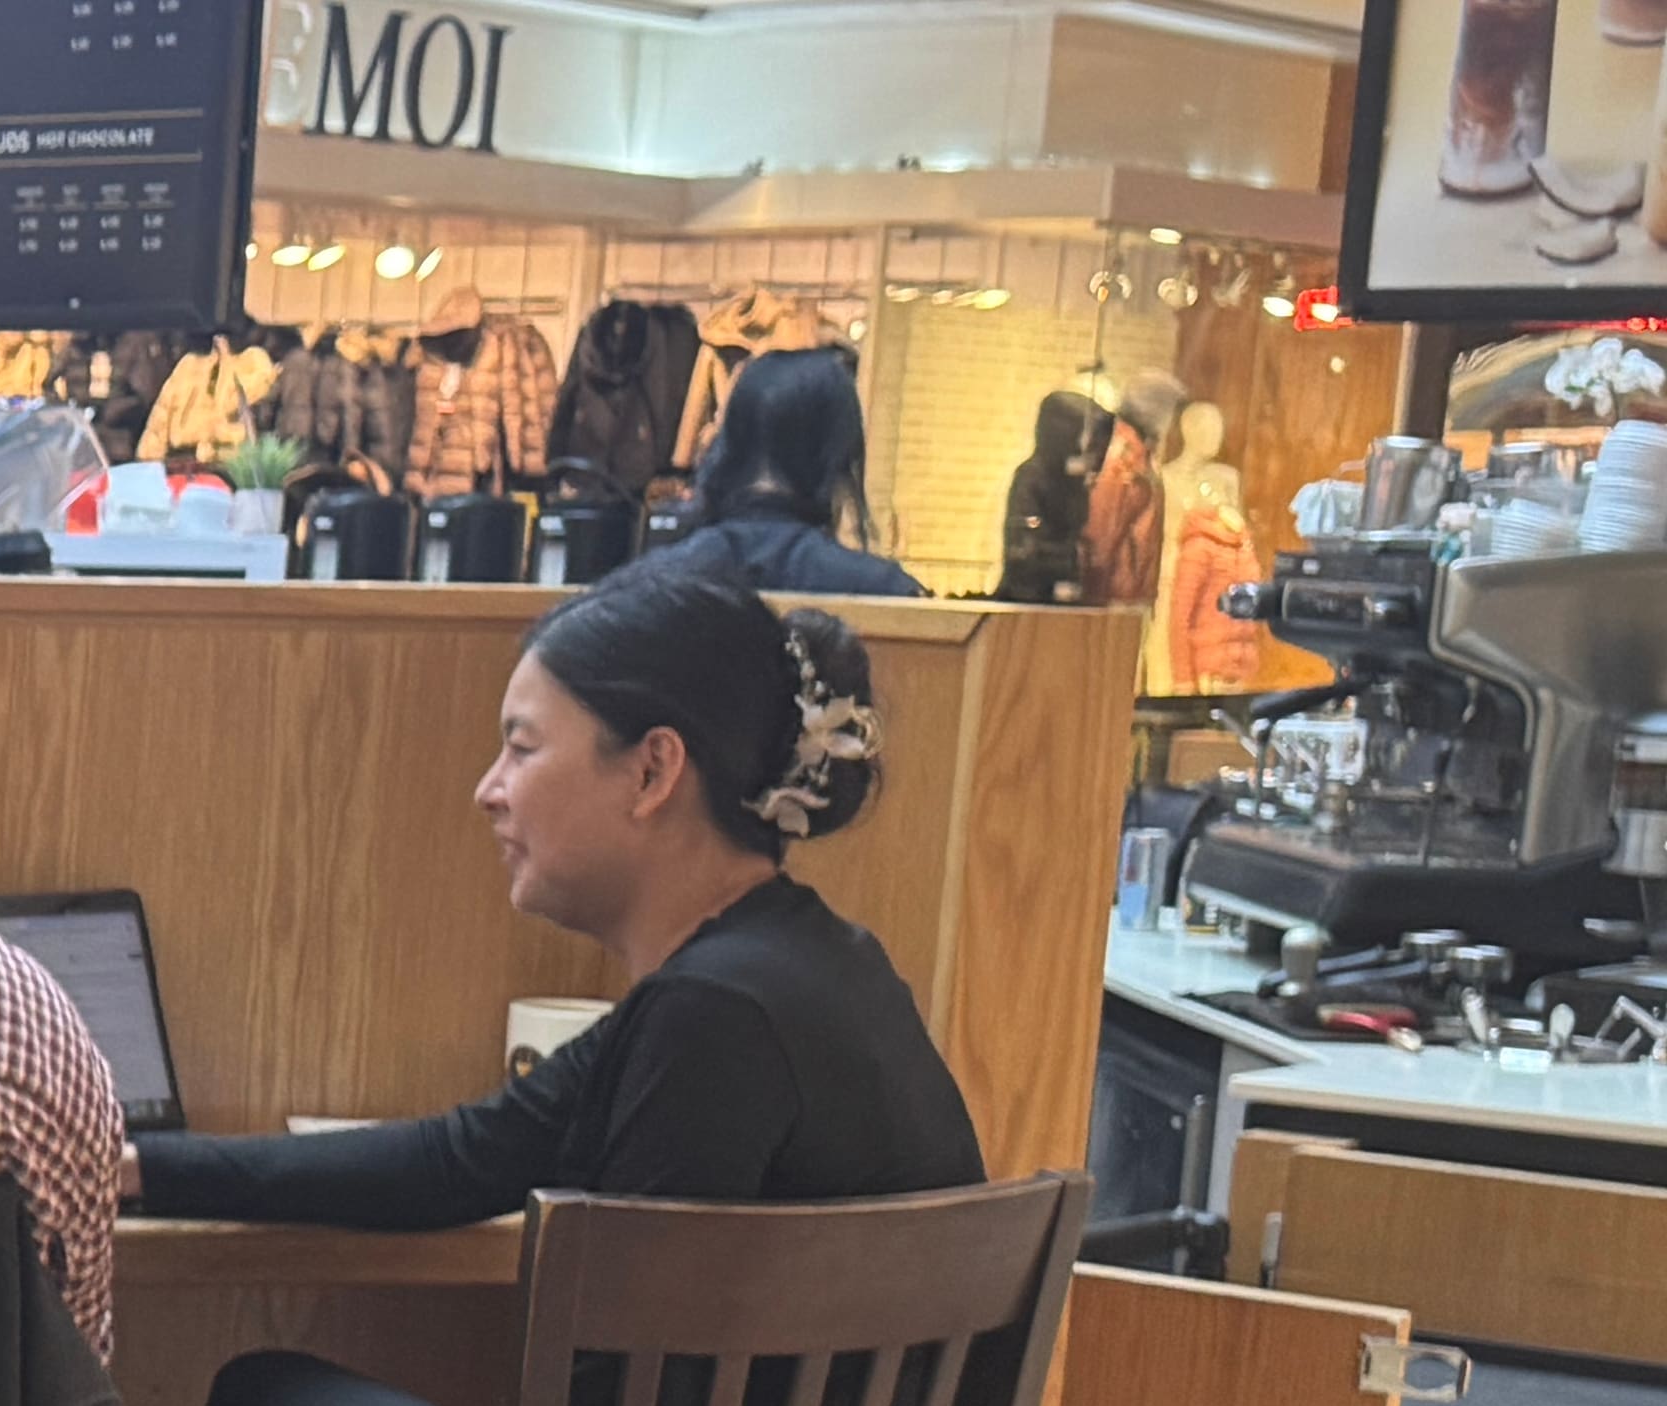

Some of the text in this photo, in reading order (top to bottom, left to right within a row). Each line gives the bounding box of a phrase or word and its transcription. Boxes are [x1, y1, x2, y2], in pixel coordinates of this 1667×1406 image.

[301, 2, 515, 155] MOI
[36, 130, 66, 149] HOT
[67, 126, 155, 148] CHOCOLATE
